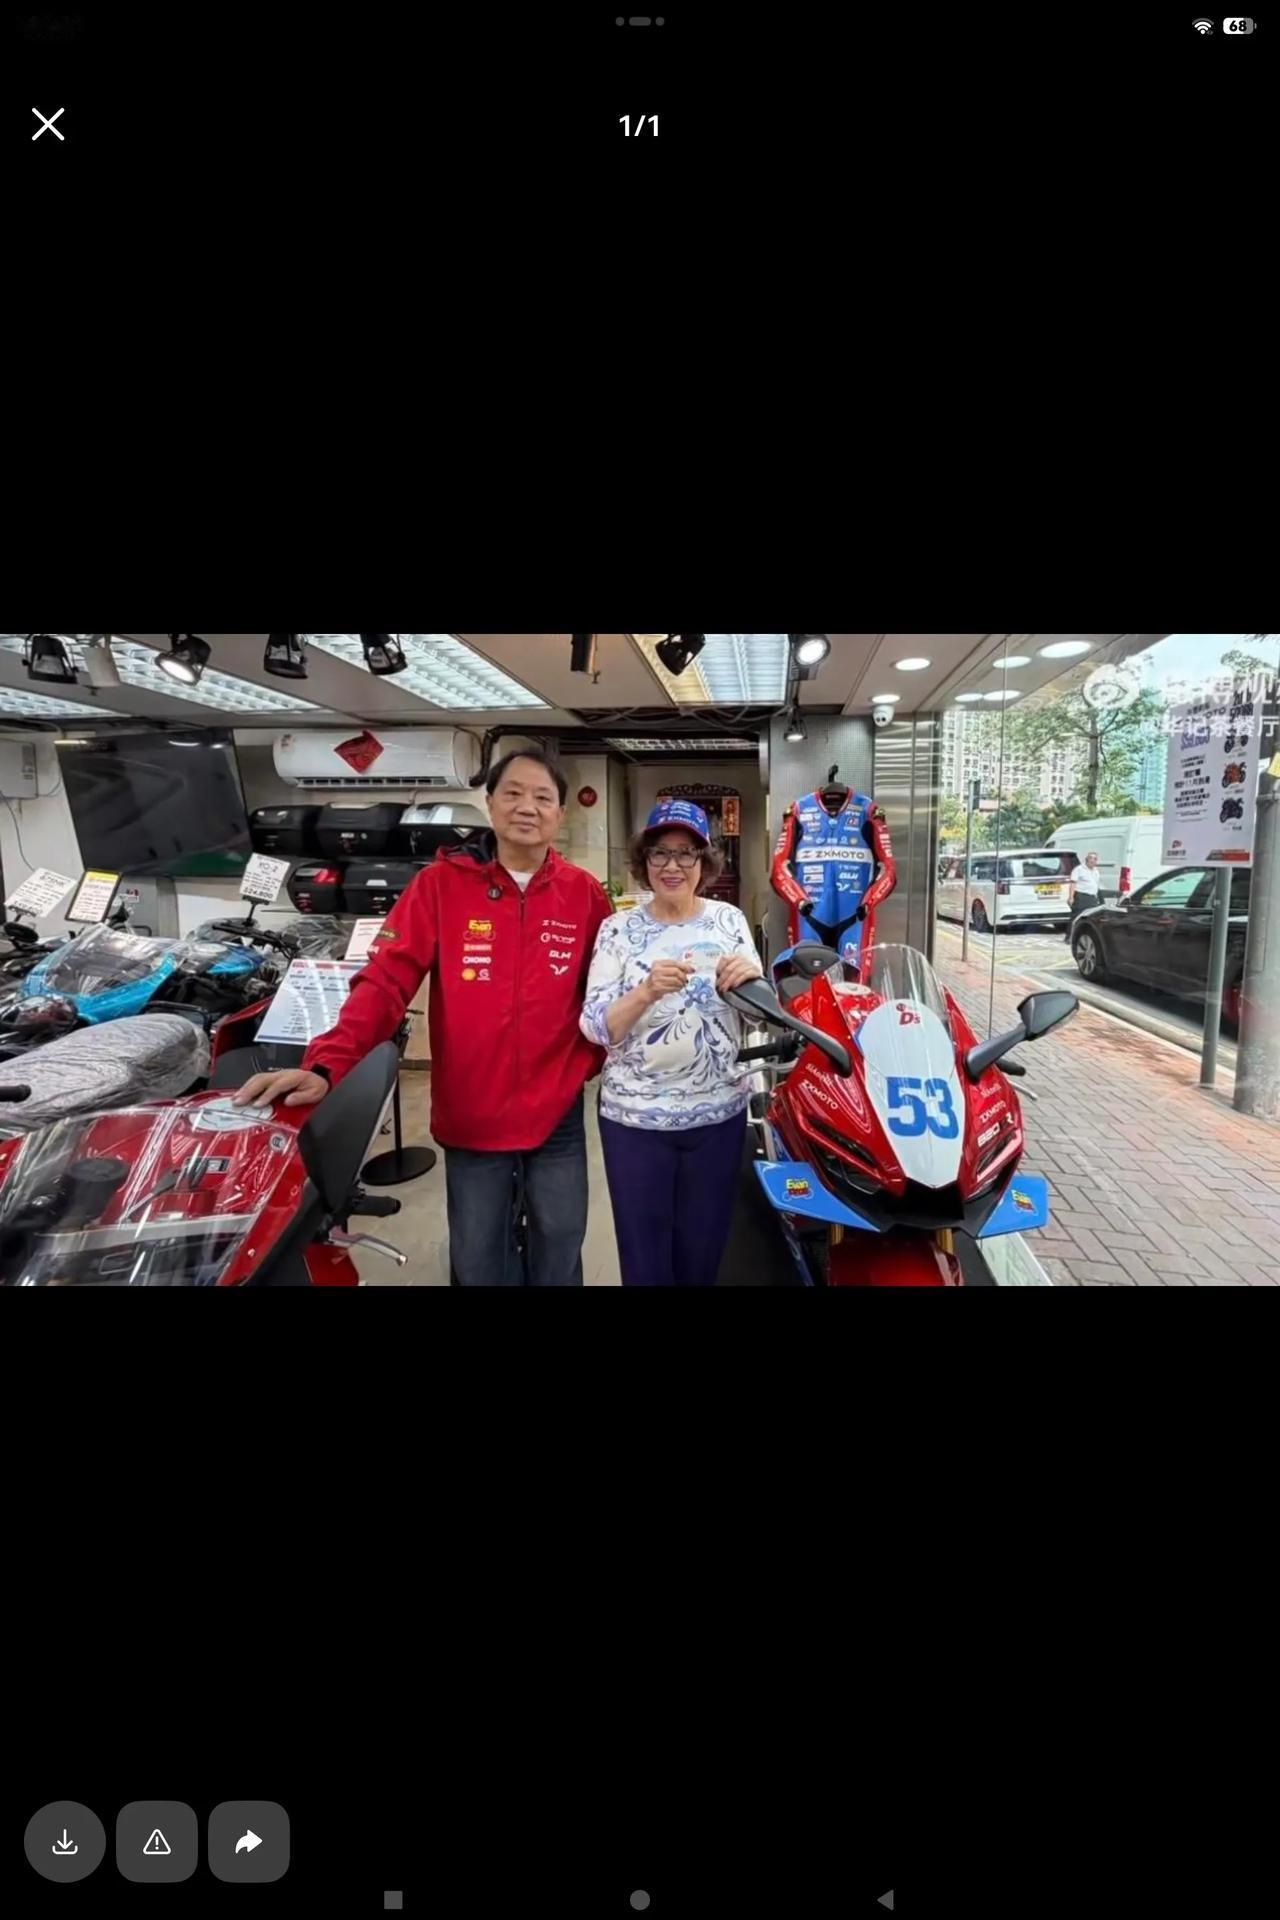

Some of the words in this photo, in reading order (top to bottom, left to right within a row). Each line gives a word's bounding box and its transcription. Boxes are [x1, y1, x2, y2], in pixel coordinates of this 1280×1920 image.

[816, 850, 865, 860] ZXMOTO
[801, 1079, 839, 1110] ZXMOTO
[886, 1076, 960, 1140] 53
